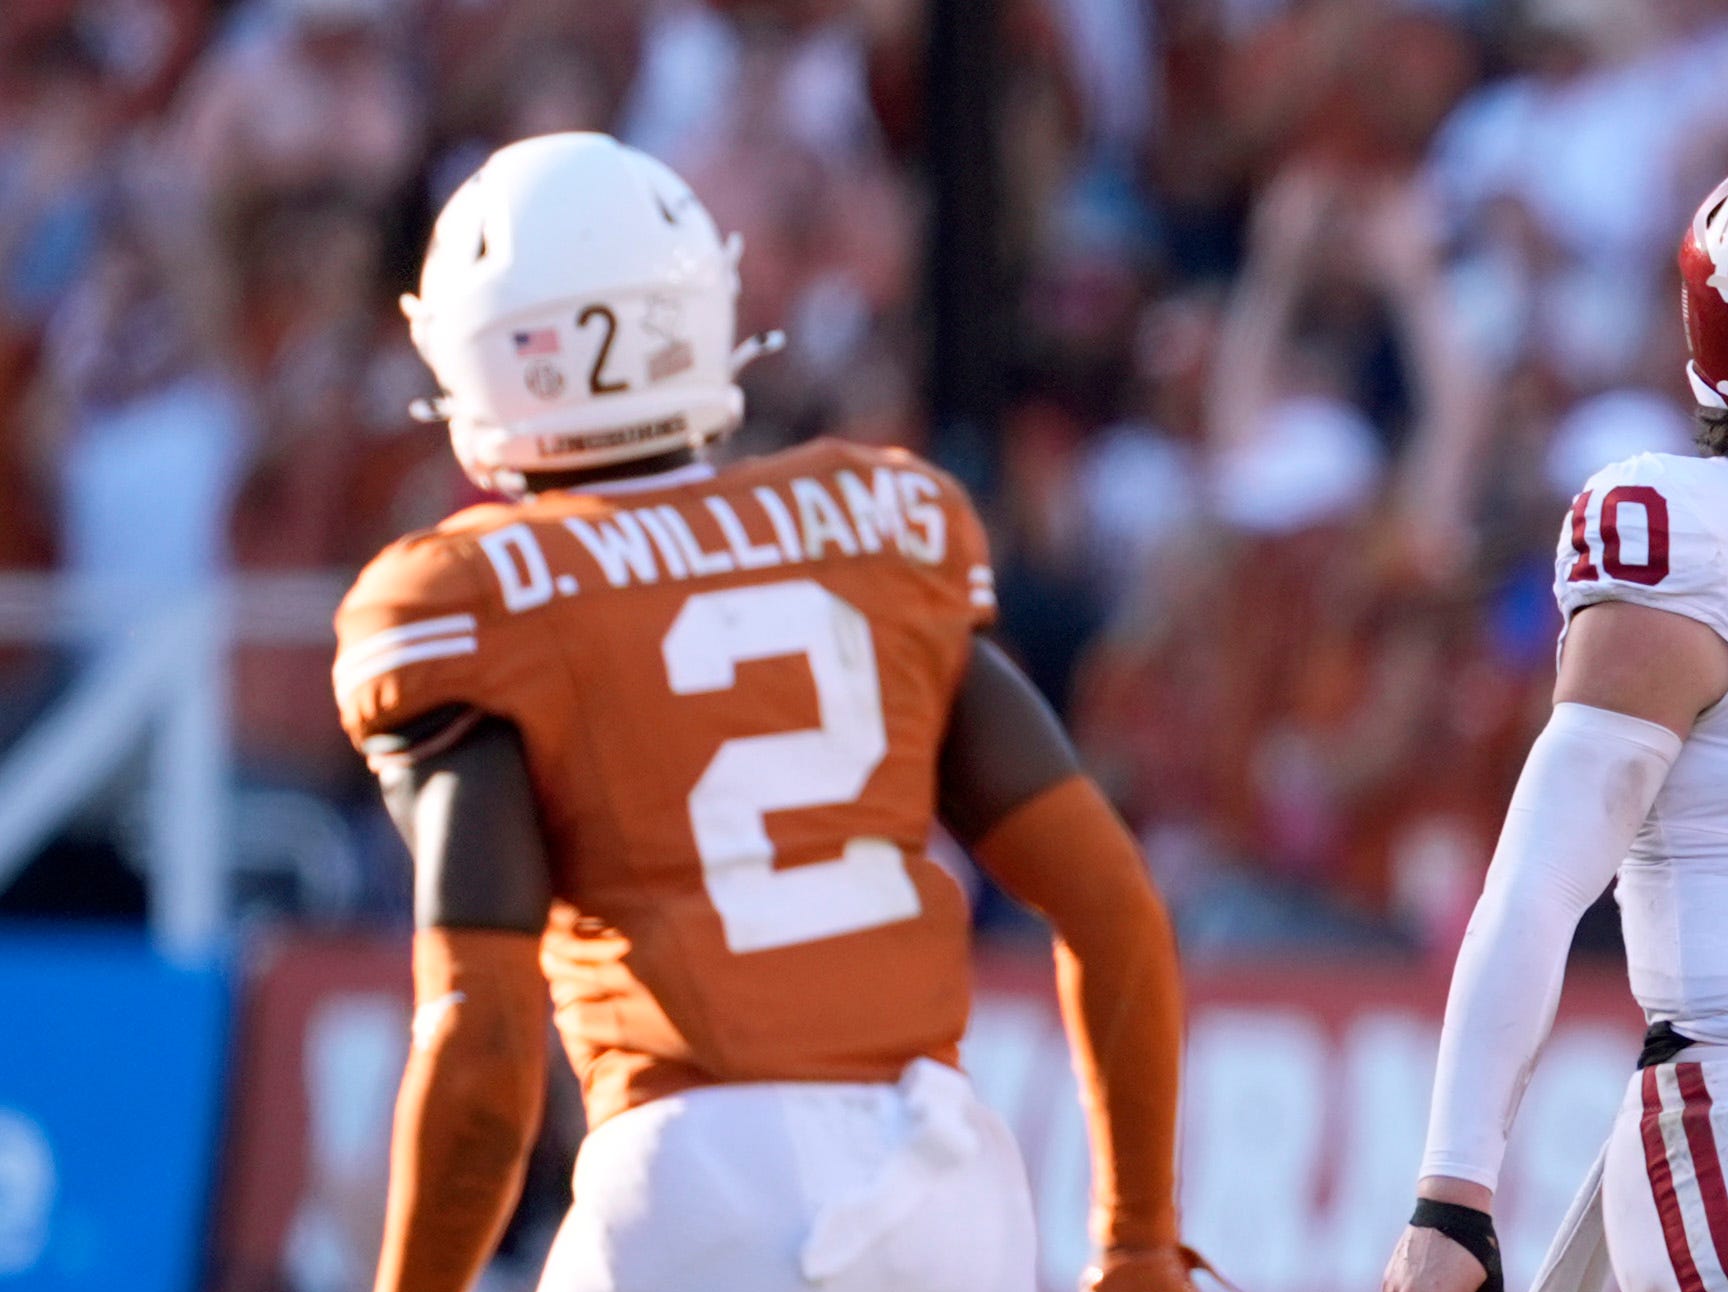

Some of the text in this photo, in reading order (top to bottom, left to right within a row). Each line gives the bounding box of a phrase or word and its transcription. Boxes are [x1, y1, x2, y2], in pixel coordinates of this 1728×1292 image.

[576, 303, 631, 395] 2
[480, 466, 946, 613] D. WILLIAMS
[1567, 485, 1670, 587] 10
[661, 580, 922, 955] 2
